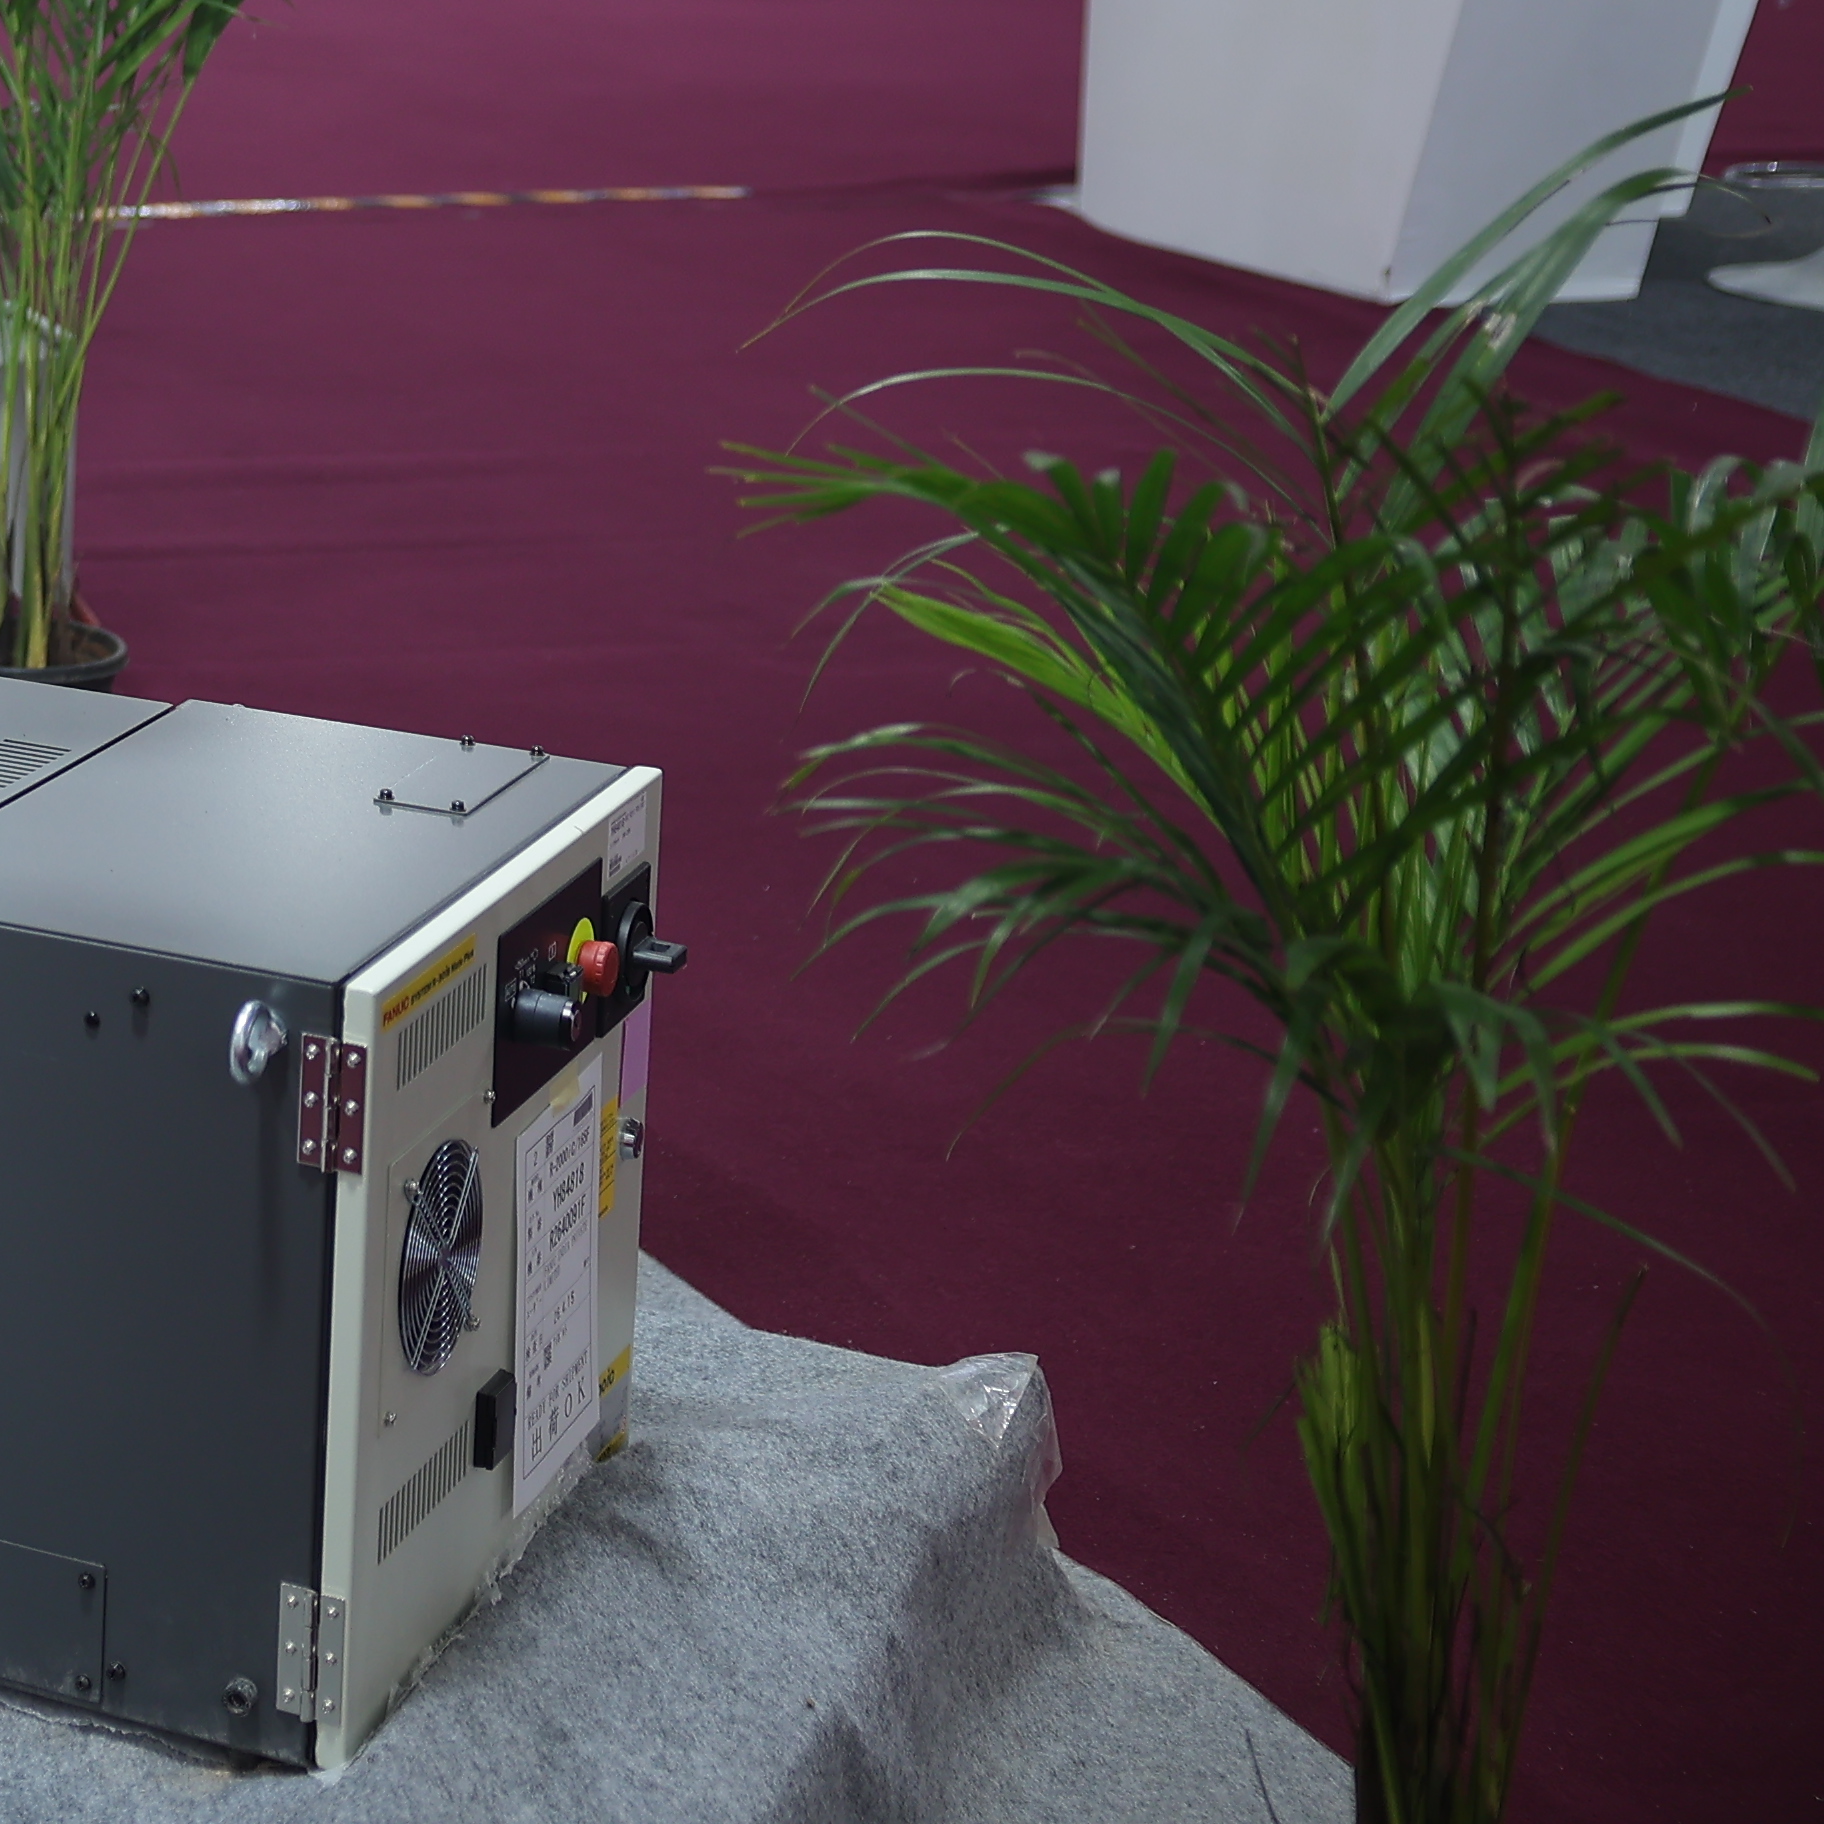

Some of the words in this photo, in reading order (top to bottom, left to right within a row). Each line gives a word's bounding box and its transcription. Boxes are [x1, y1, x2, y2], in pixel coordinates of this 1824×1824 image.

[383, 996, 410, 1026] FANUC
[552, 1162, 585, 1212] YH84818
[549, 1194, 587, 1251] R2640091F
